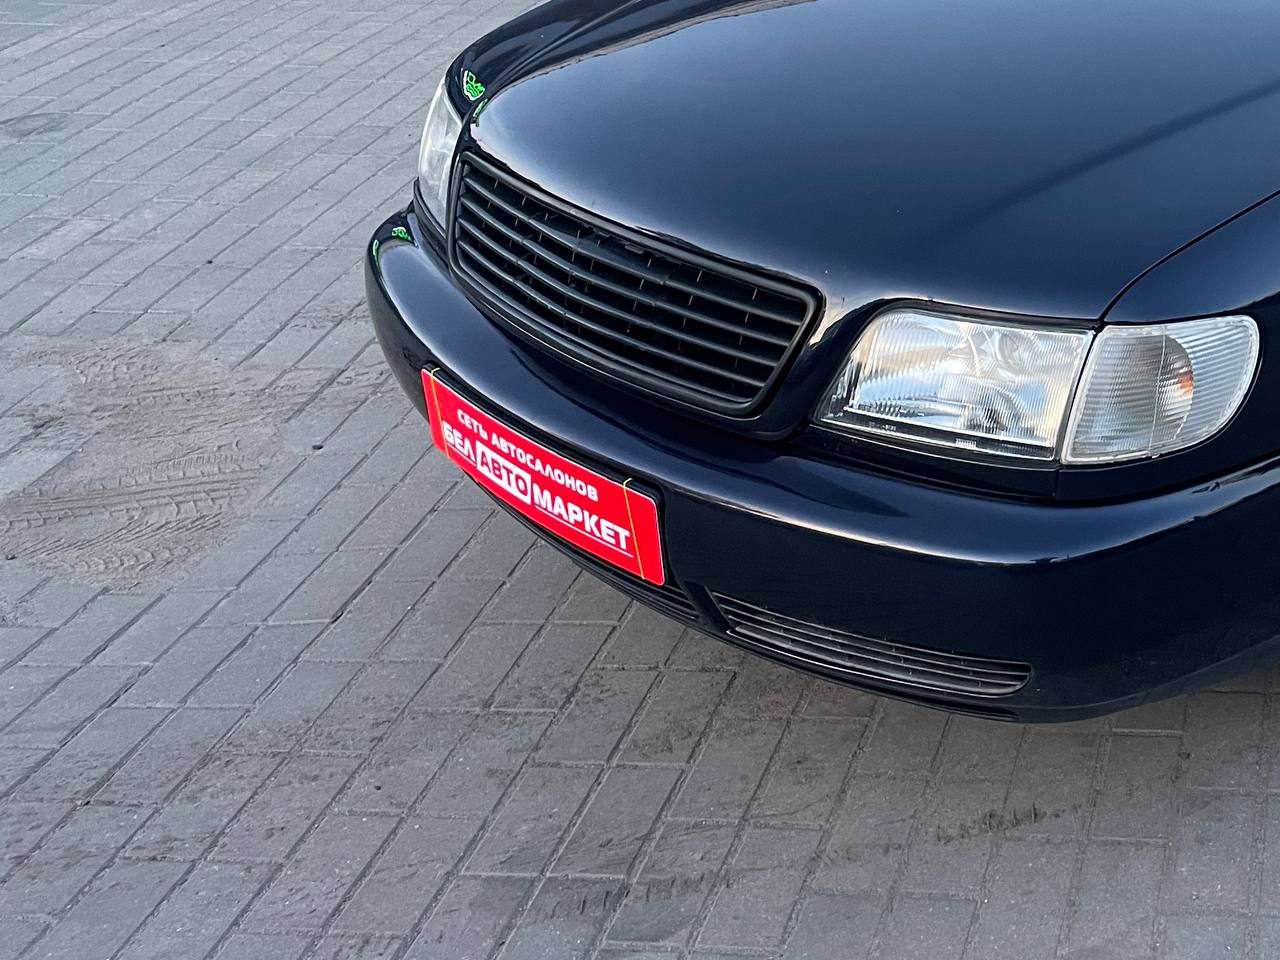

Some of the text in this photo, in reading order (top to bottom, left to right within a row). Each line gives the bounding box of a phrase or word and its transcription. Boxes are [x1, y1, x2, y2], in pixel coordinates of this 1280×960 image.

[442, 420, 631, 551] БЕЛ АВТО МАРКЕТ
[457, 408, 599, 502] СЕТЬ АВТОСАЛОНОВ
